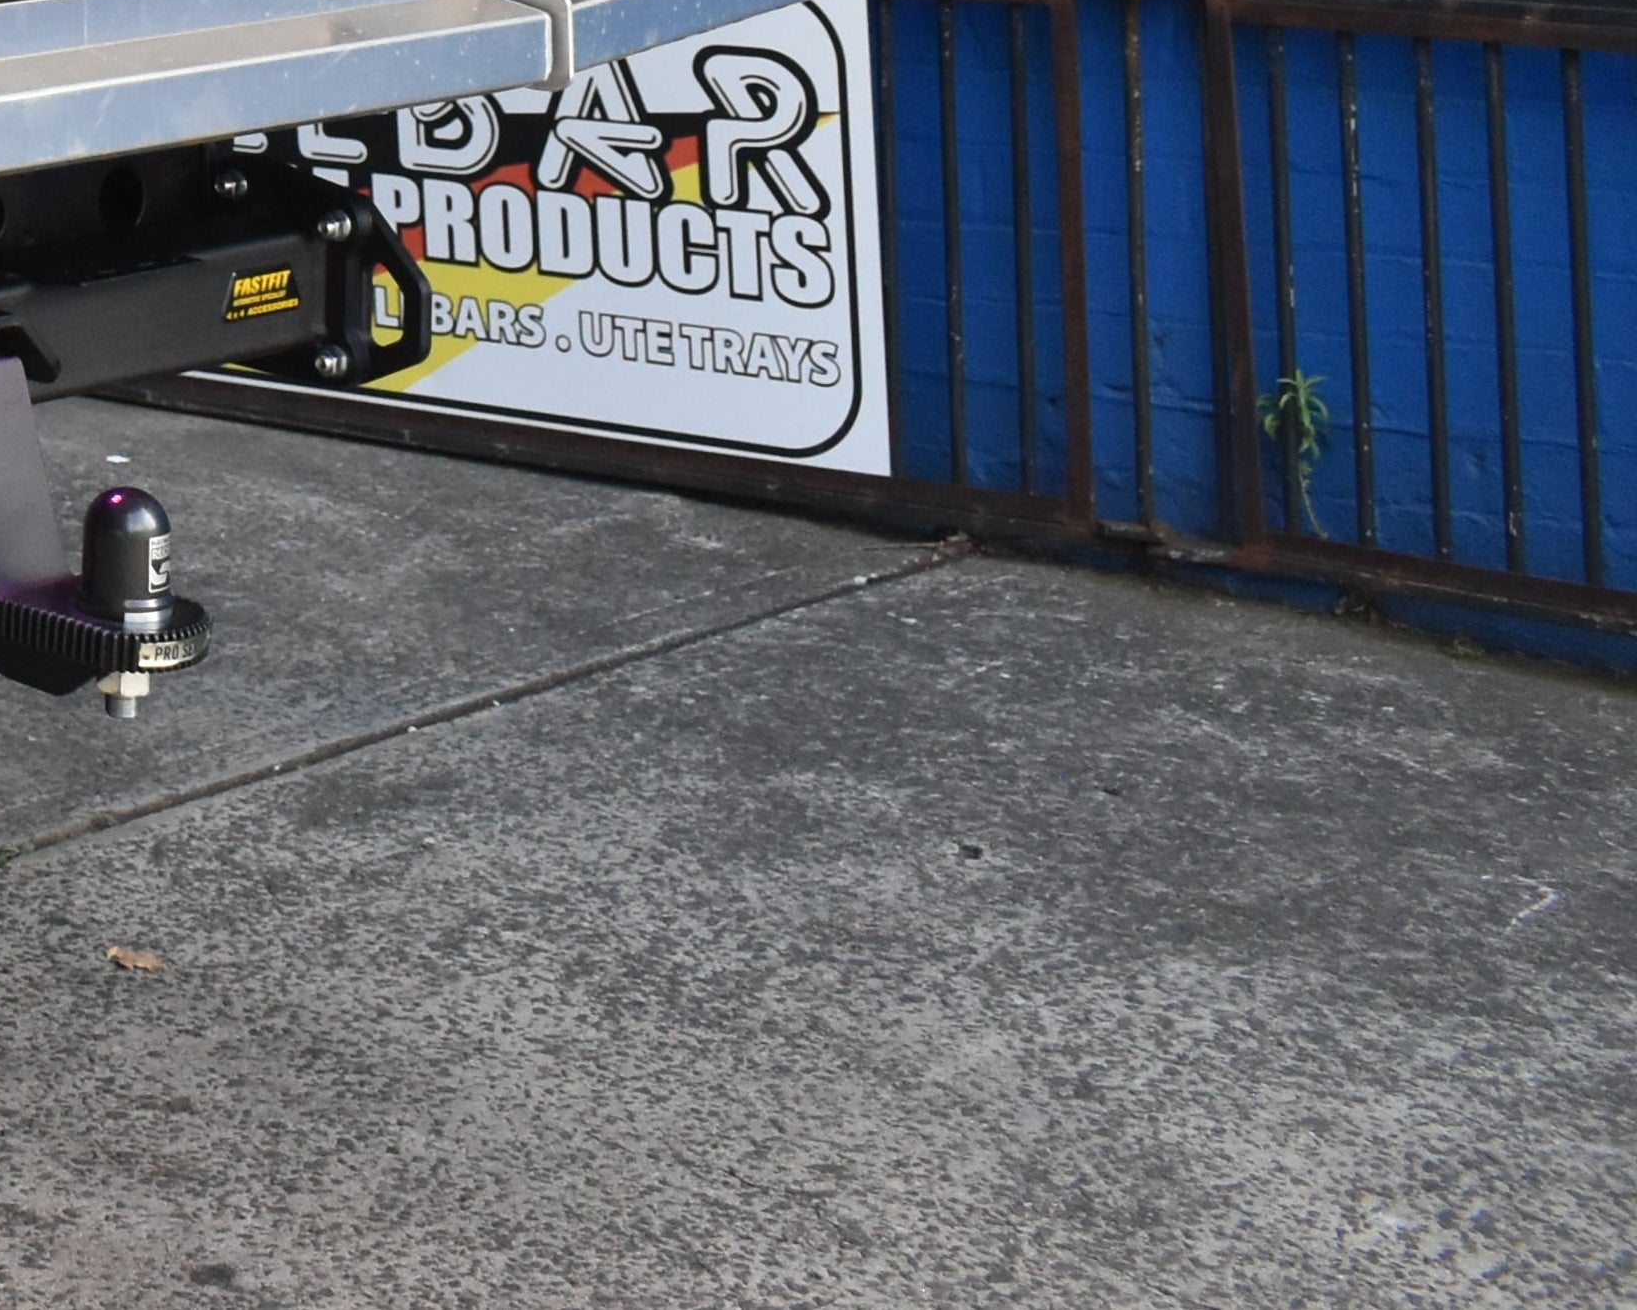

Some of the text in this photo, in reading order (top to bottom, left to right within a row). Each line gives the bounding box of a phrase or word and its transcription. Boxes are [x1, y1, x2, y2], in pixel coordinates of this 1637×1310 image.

[371, 173, 838, 312] PRODUCTS
[232, 270, 292, 298] FASTFIT
[428, 287, 546, 350] BARS
[578, 310, 678, 368] UTE
[680, 324, 842, 388] TRAYS
[155, 643, 180, 661] PRO
